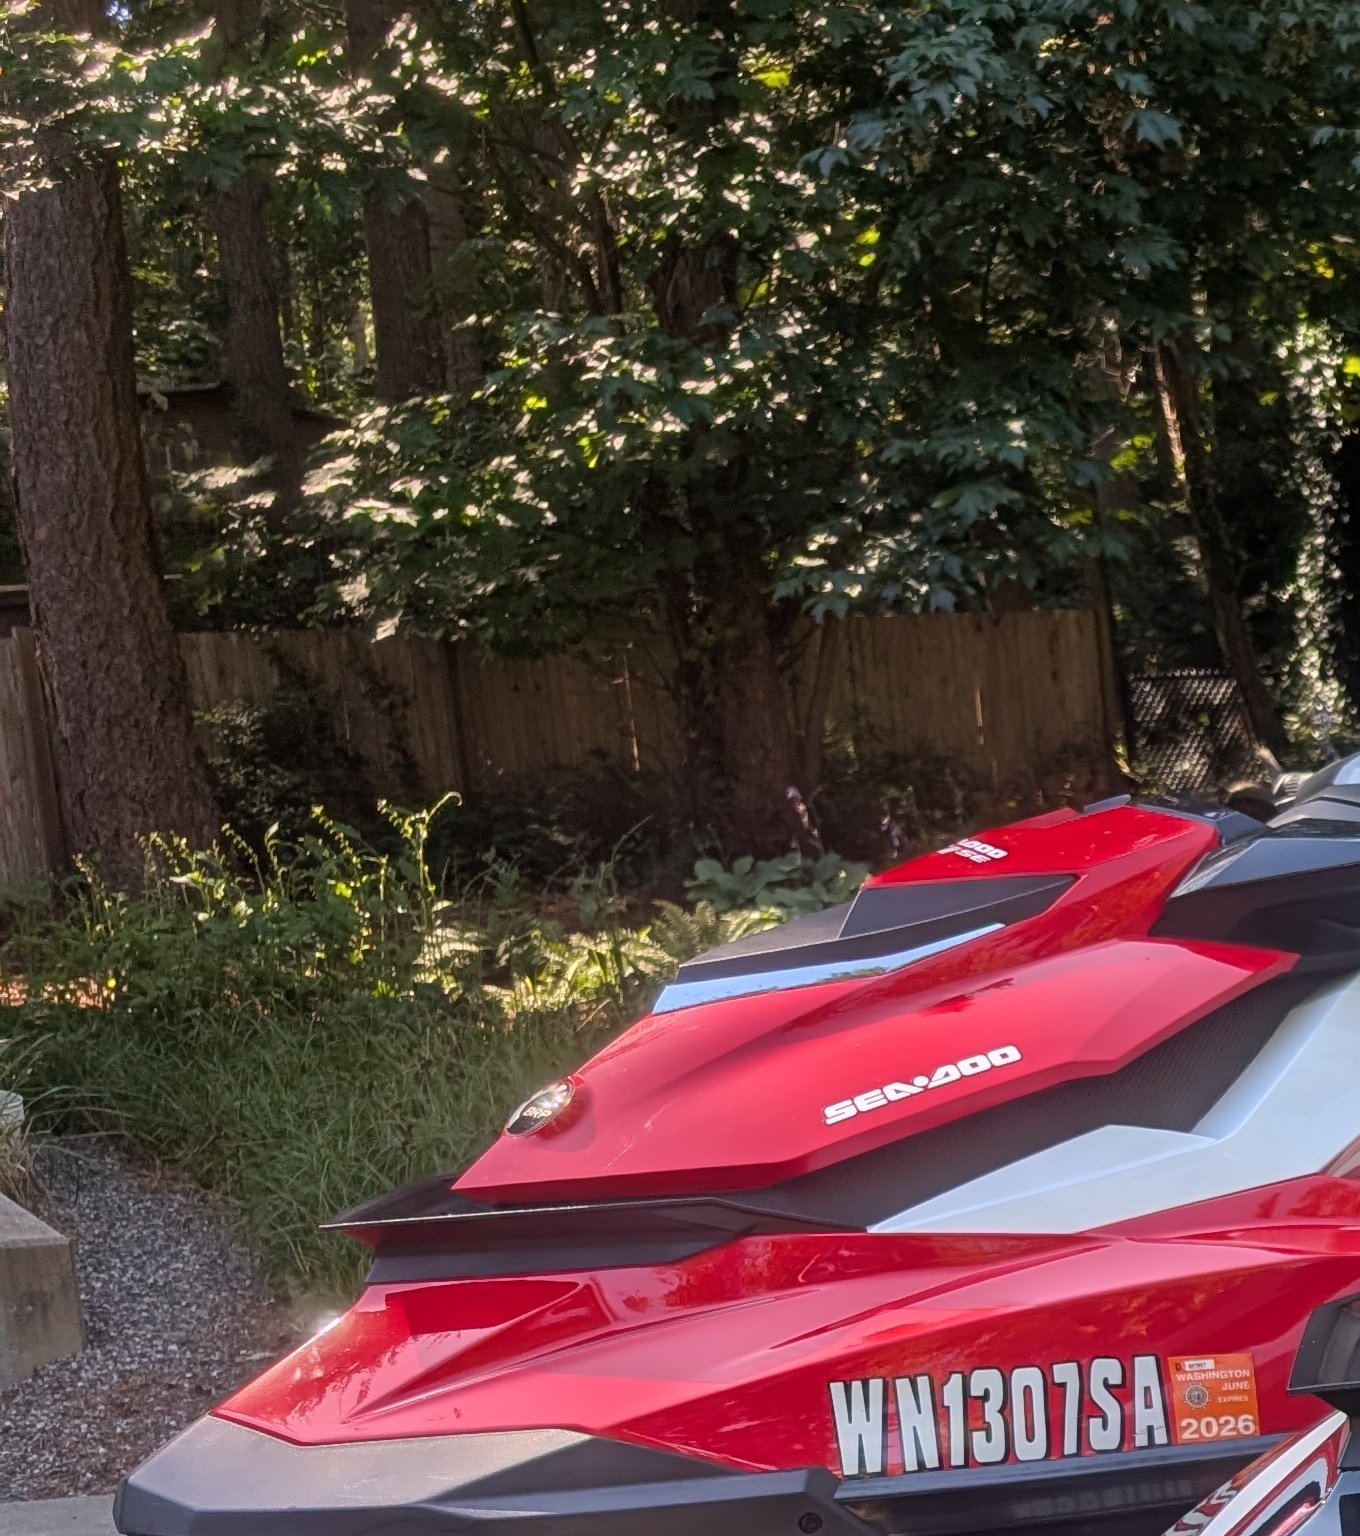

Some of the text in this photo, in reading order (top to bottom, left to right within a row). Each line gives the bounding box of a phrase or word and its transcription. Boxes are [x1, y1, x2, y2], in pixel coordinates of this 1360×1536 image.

[523, 1106, 552, 1118] BRP
[1176, 1369, 1251, 1381] WASHINGTON
[1222, 1381, 1250, 1391] JUNE
[829, 1355, 1169, 1477] WN1307SA
[1181, 1414, 1256, 1439] 2026
